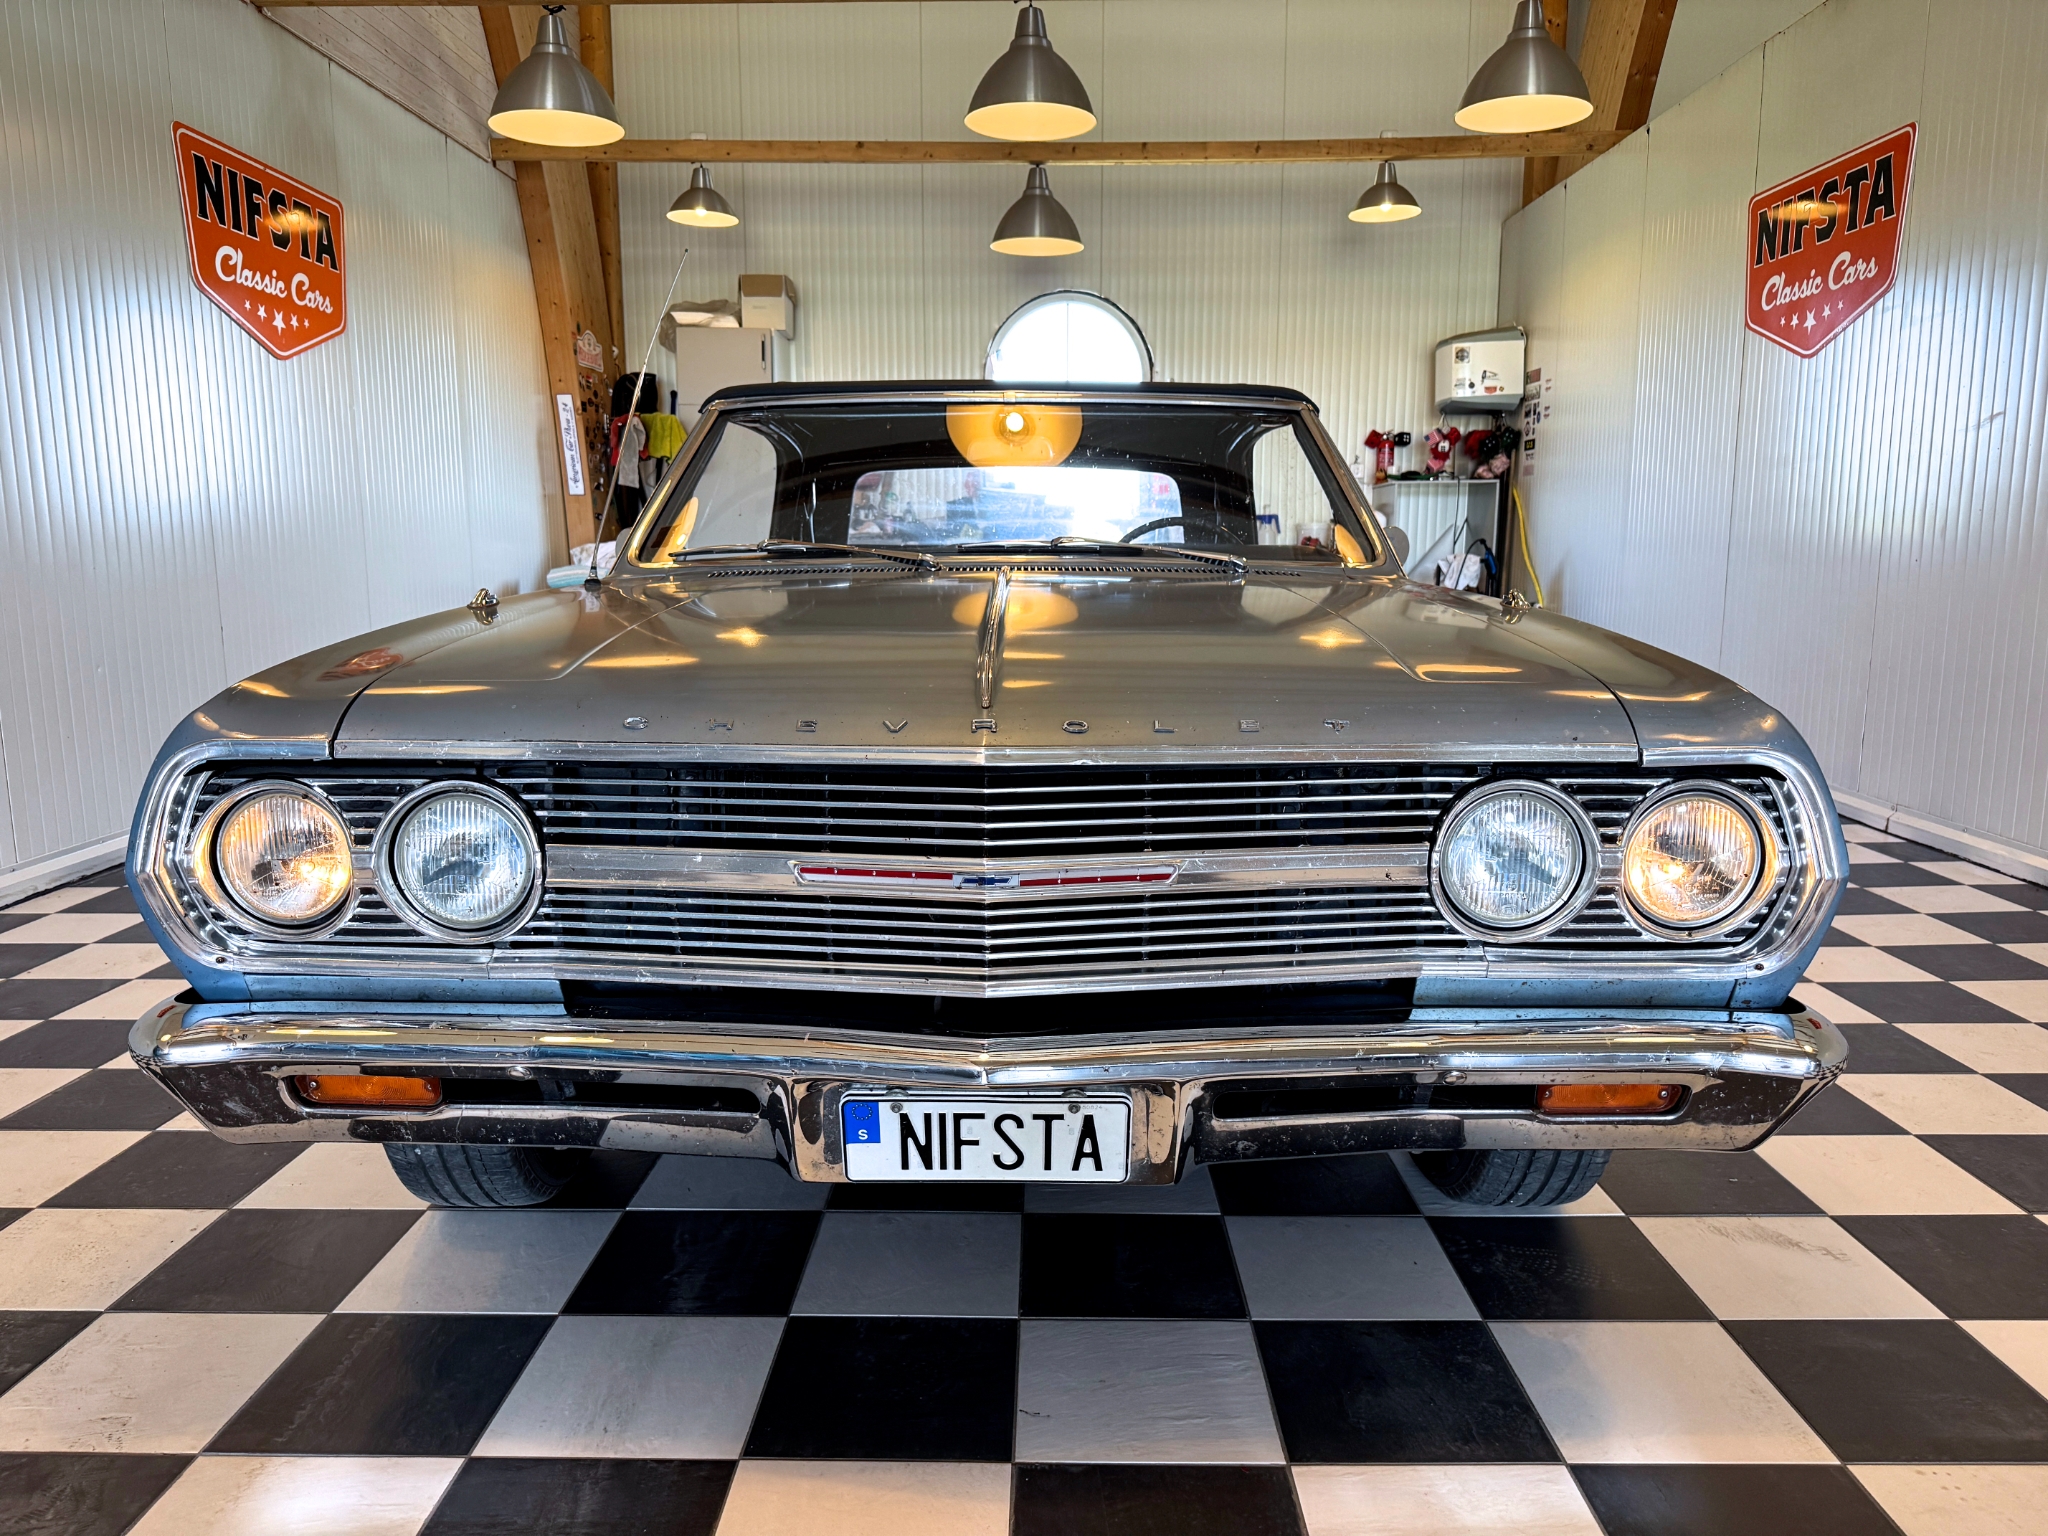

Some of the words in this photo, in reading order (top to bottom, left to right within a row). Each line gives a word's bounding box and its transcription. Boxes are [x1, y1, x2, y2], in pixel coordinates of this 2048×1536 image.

[191, 150, 340, 273] NIFSTA
[1754, 151, 1896, 269] NIFSTA
[215, 245, 288, 298] Classic
[291, 272, 334, 314] Cars
[1761, 268, 1824, 311] Classic
[1828, 251, 1878, 291] Cars
[623, 715, 1351, 734] CHEVROLET
[857, 1128, 869, 1141] S
[899, 1111, 1104, 1172] NIFSTA
